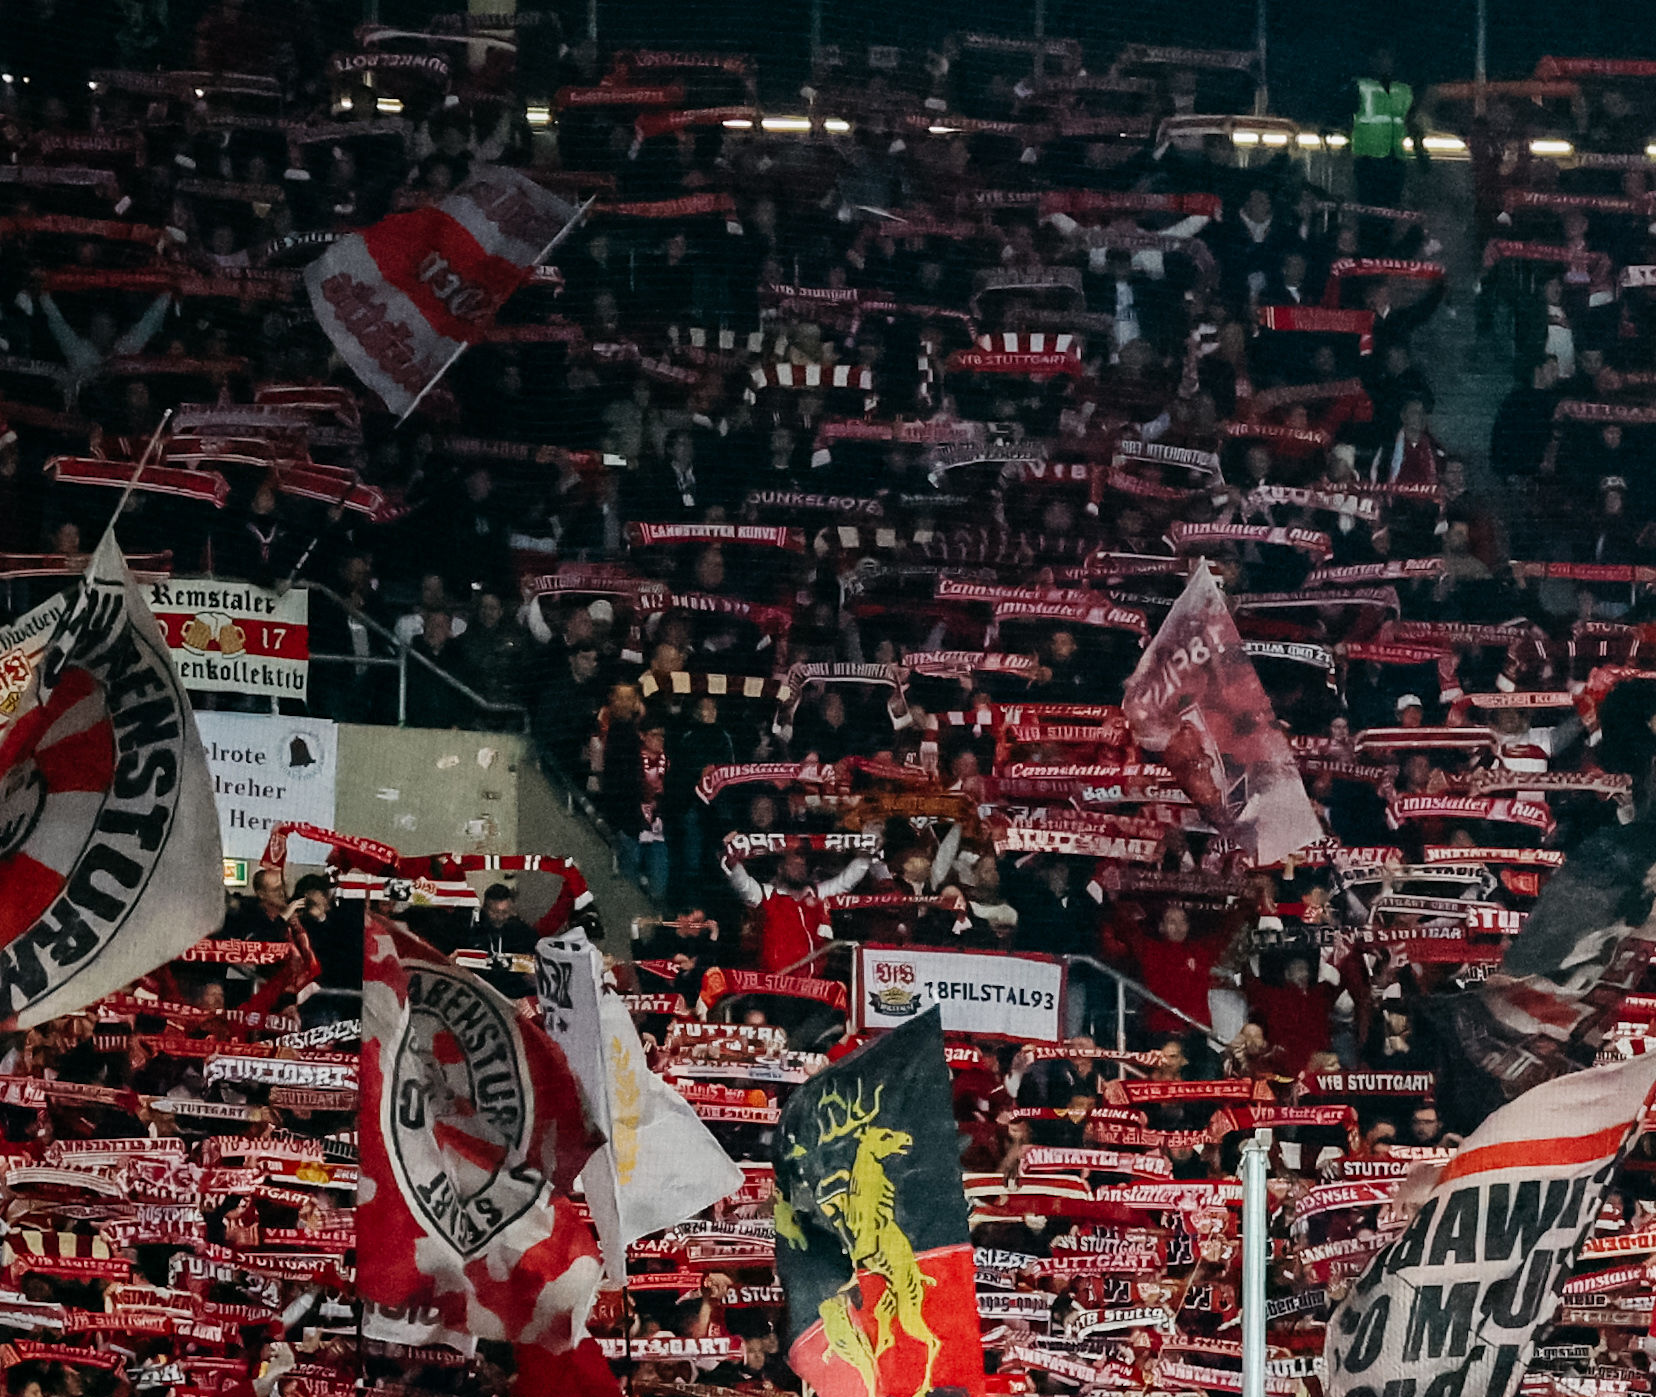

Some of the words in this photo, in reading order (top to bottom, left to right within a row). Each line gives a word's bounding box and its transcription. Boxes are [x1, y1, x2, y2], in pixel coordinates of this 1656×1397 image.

[150, 582, 276, 613] Remstaler
[261, 627, 286, 650] 17
[1317, 1074, 1343, 1090] VfB
[1348, 1073, 1433, 1091] STUTTGART
